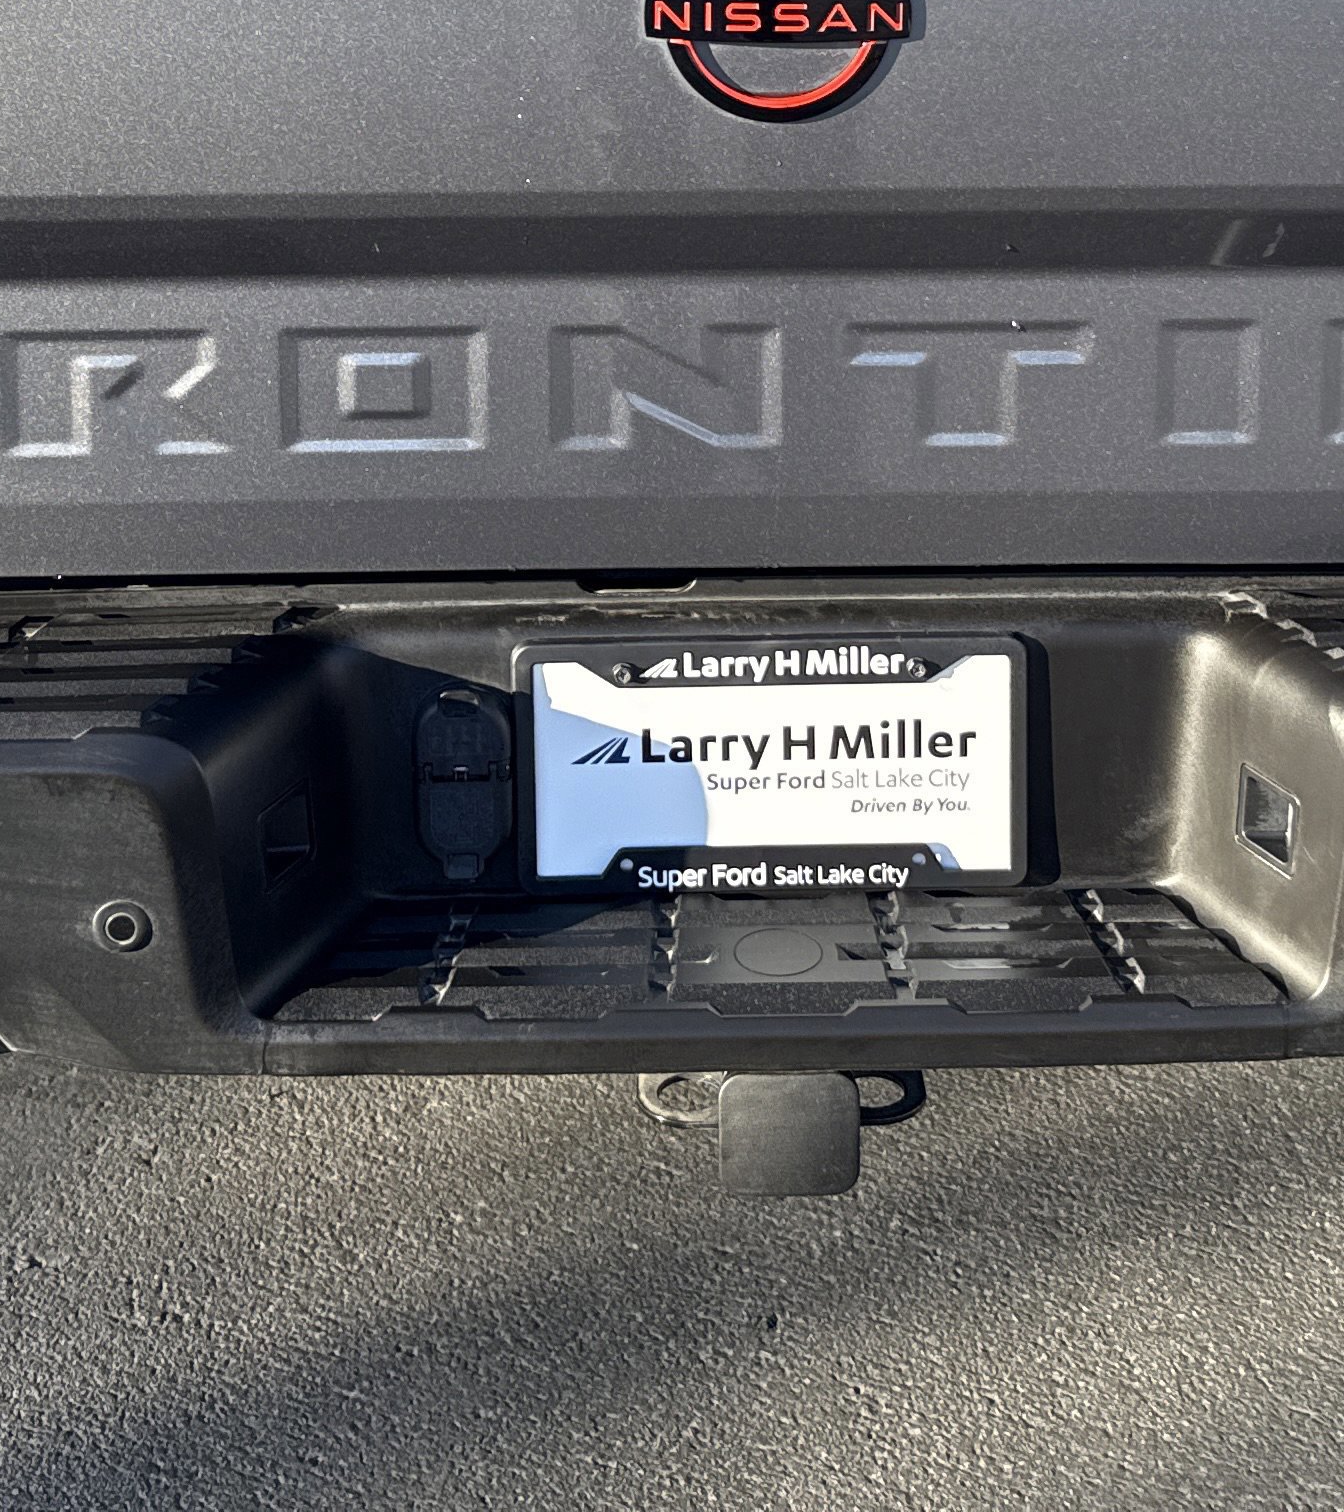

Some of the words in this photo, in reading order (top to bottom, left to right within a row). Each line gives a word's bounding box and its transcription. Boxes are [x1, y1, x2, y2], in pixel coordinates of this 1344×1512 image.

[653, 0, 904, 34] NISSAN
[682, 651, 770, 683] Larry
[774, 649, 801, 676] H
[805, 645, 905, 676] Miller
[641, 728, 771, 770] Larry
[783, 725, 816, 760] H
[828, 719, 977, 760] Miller
[707, 772, 771, 794] Super
[777, 770, 826, 789] Ford
[831, 768, 869, 789] Salt
[875, 767, 923, 788] Lake
[928, 768, 970, 791] City
[850, 797, 907, 813] Driven
[912, 798, 934, 816] By
[638, 865, 708, 892] Super
[712, 862, 768, 887] Ford
[773, 864, 814, 886] Salt
[817, 864, 865, 885] Lake
[868, 862, 909, 887] City
